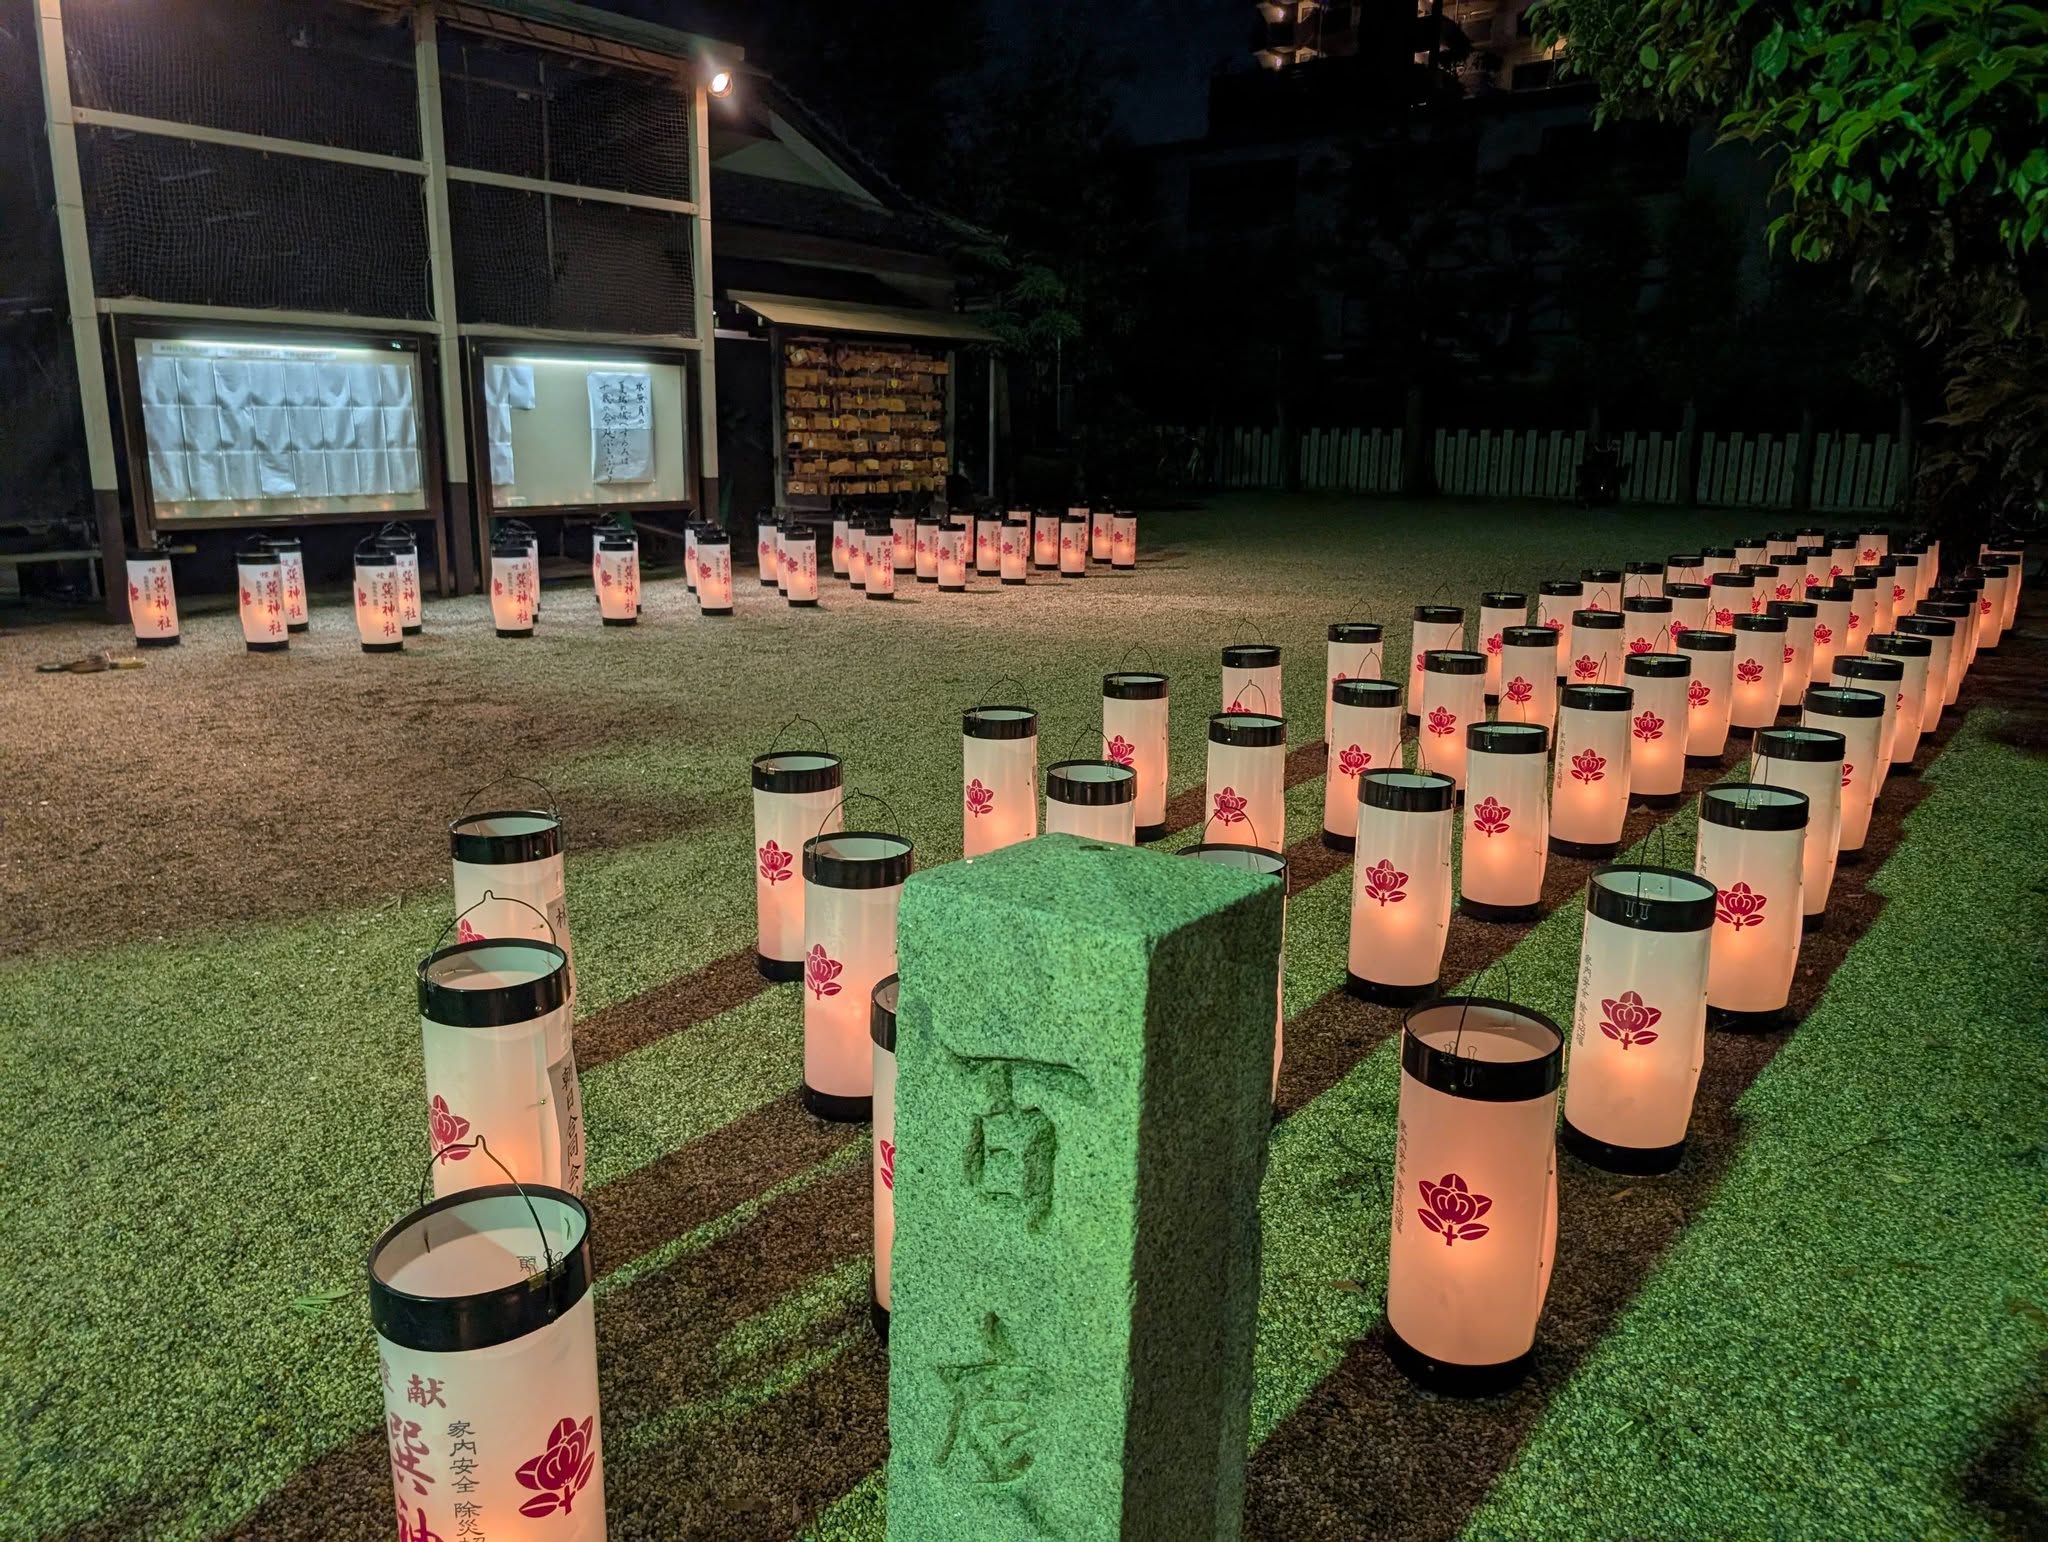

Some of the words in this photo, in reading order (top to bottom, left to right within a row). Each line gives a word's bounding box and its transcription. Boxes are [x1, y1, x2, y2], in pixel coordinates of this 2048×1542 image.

[153, 576, 173, 631] 巽神社
[266, 581, 283, 636] 巽神社
[285, 567, 303, 619] 巽神社
[381, 582, 398, 637] 巽神社
[402, 570, 418, 621] 巽神社
[516, 573, 529, 624] 巽神社
[561, 1060, 581, 1198] 朝日合同会
[447, 1420, 481, 1494] 家内安全
